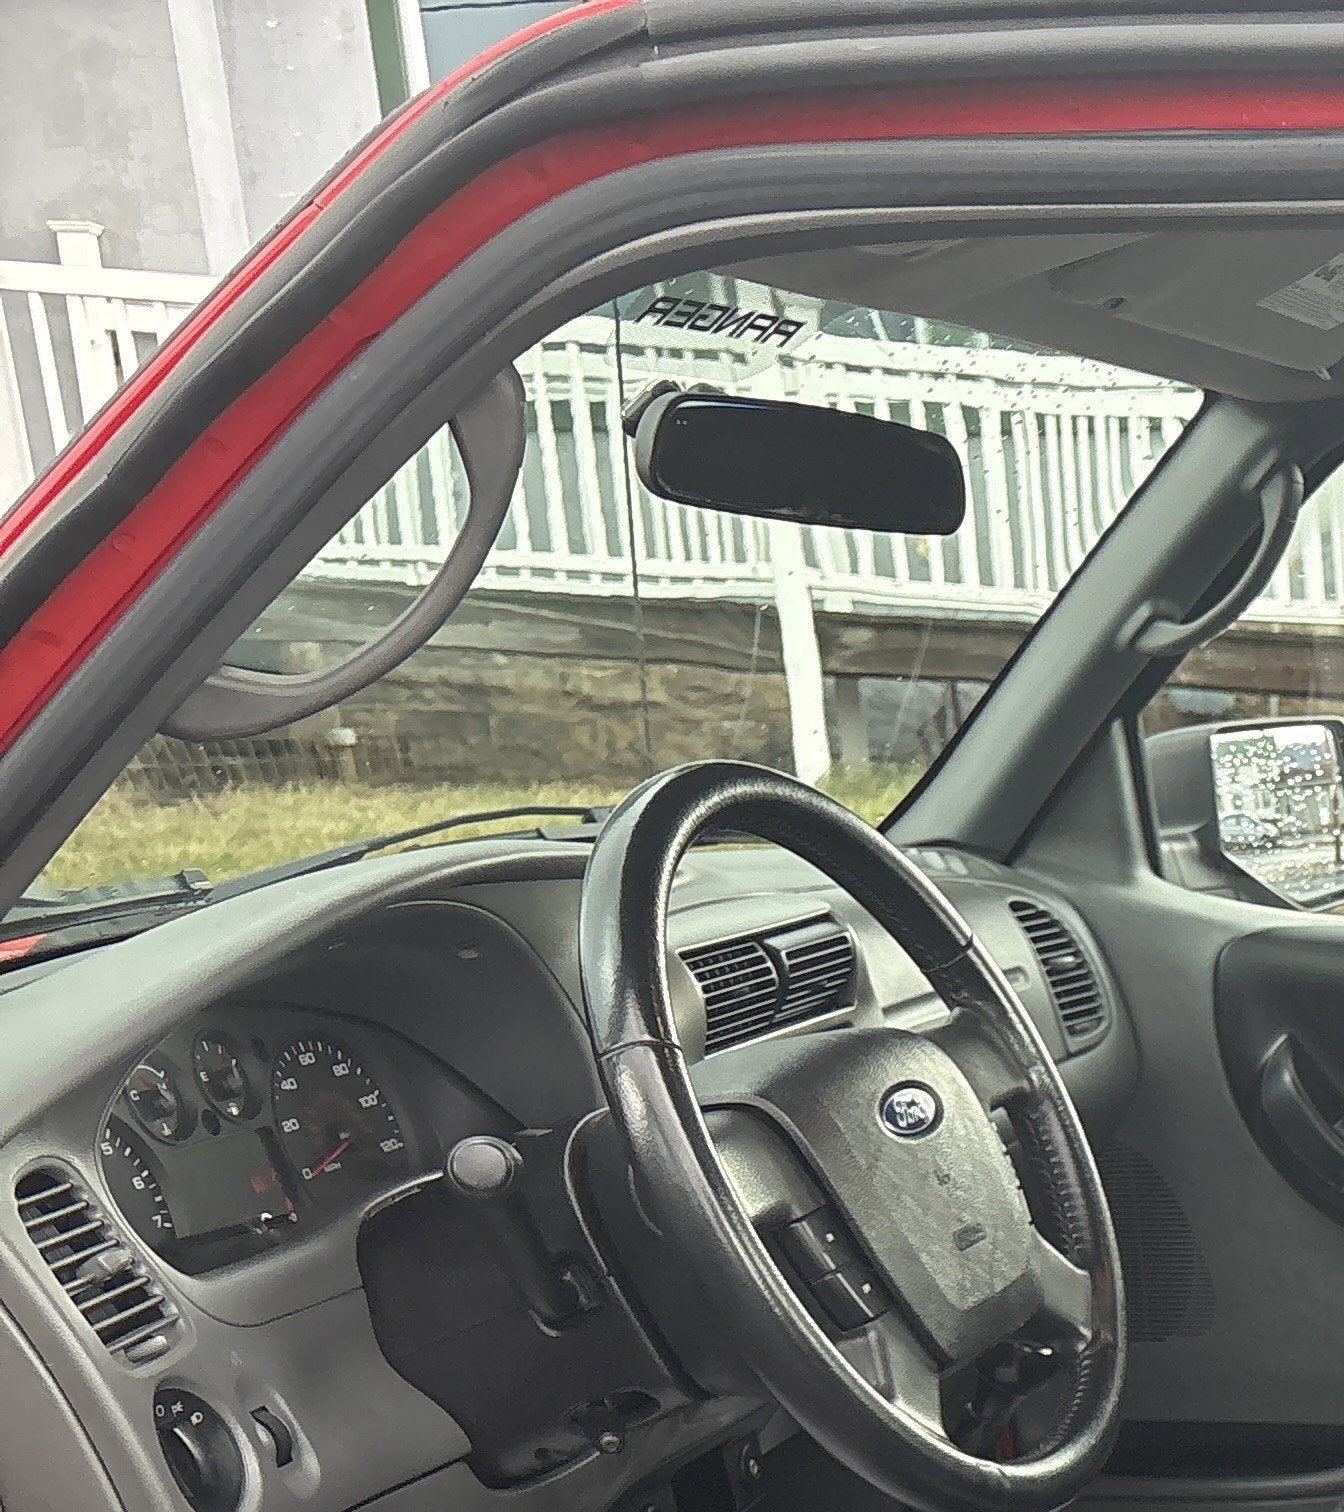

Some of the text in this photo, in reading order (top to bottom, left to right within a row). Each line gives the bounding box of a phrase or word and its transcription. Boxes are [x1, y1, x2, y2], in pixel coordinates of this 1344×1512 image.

[281, 1118, 300, 1133] 20
[100, 1142, 113, 1156] 5
[131, 1176, 145, 1190] 6
